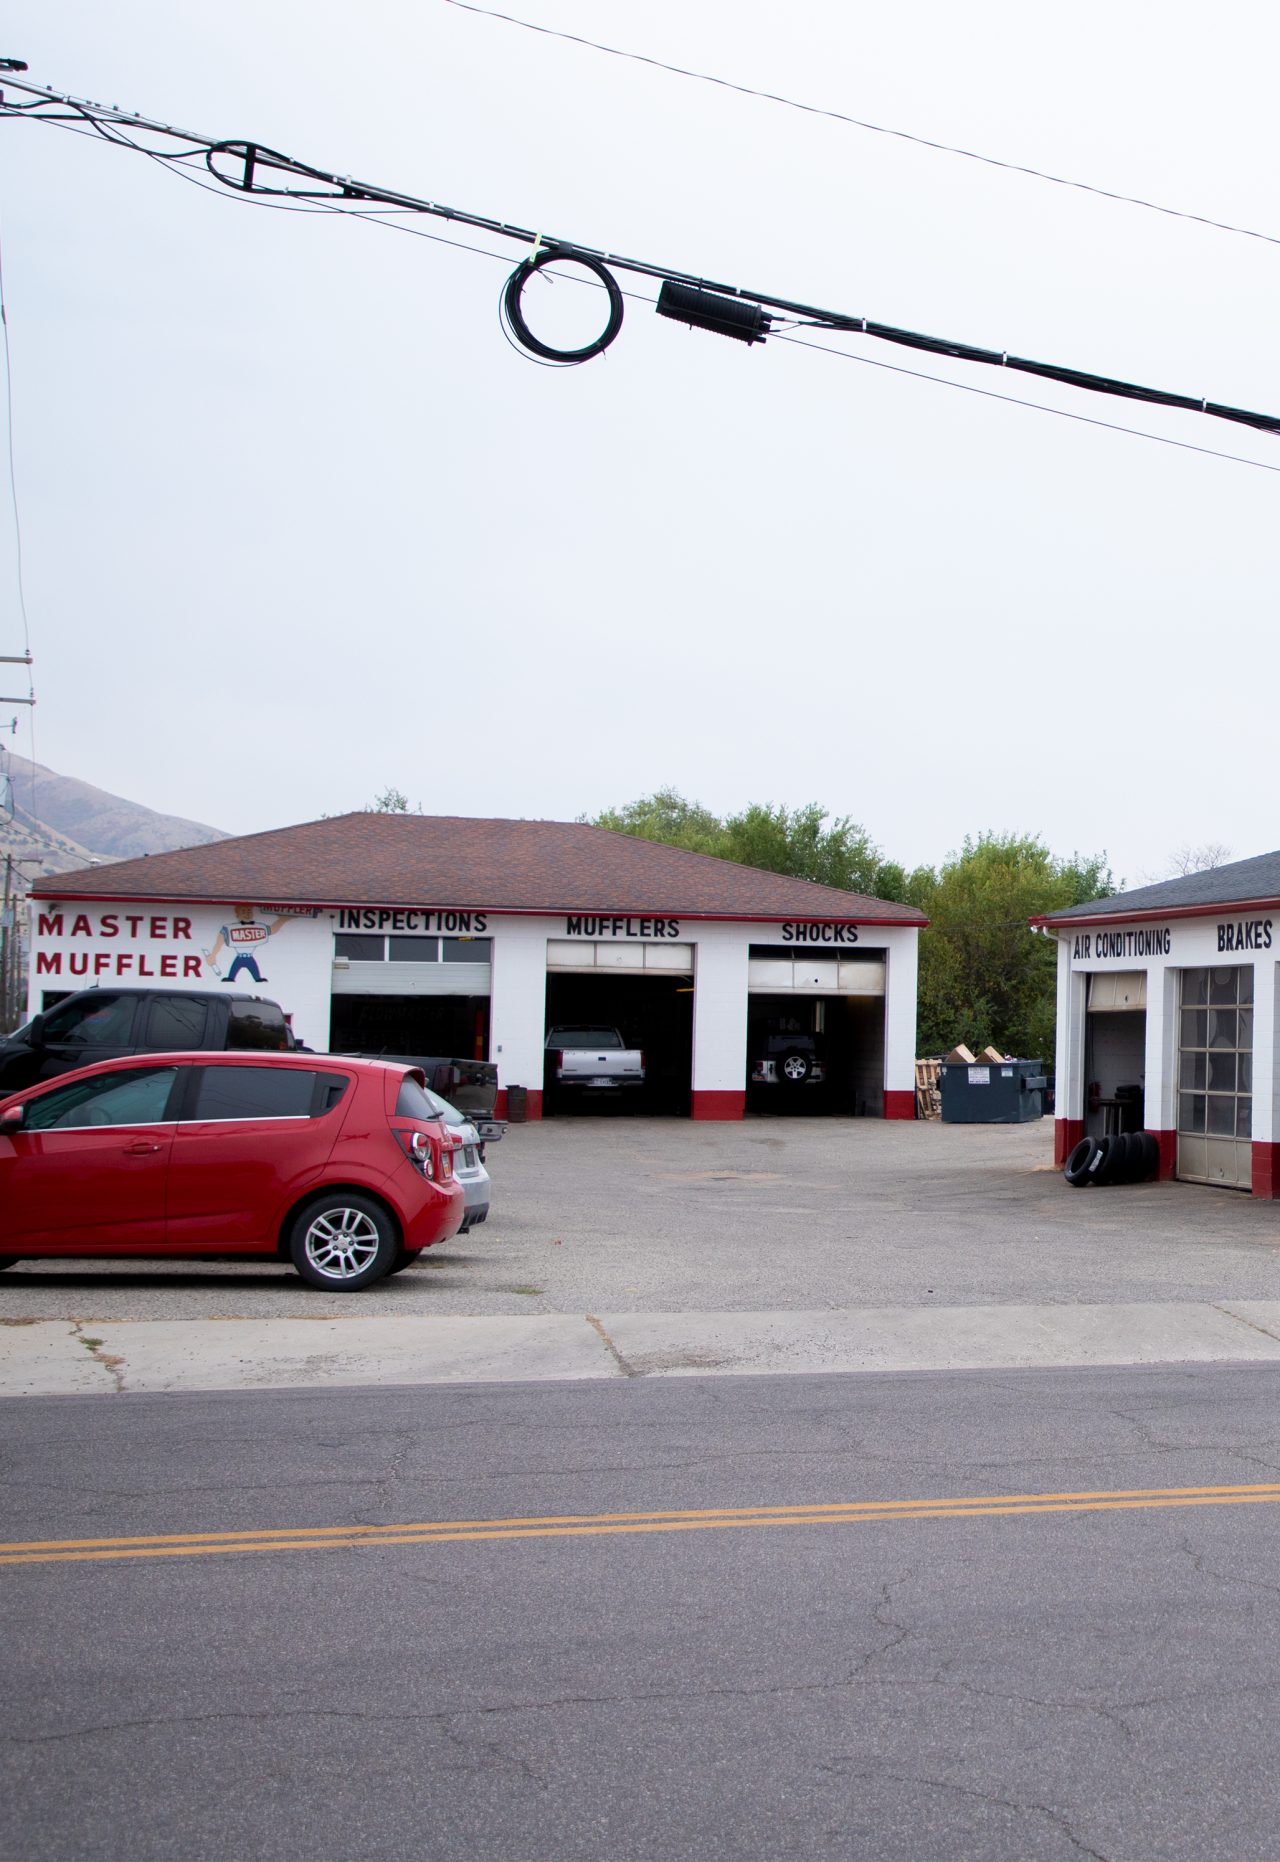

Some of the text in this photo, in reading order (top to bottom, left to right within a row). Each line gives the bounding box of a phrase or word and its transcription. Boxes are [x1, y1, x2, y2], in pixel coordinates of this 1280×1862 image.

[38, 913, 192, 939] MASTER
[339, 909, 488, 932] INSPECTIONS
[566, 916, 680, 938] MUFFLERS
[782, 922, 858, 943] SHOCKS
[232, 928, 266, 941] MASTER
[1073, 927, 1171, 960] AIR CONDITIONING
[1217, 919, 1273, 952] BRAKES
[36, 951, 203, 978] MUFFLER
